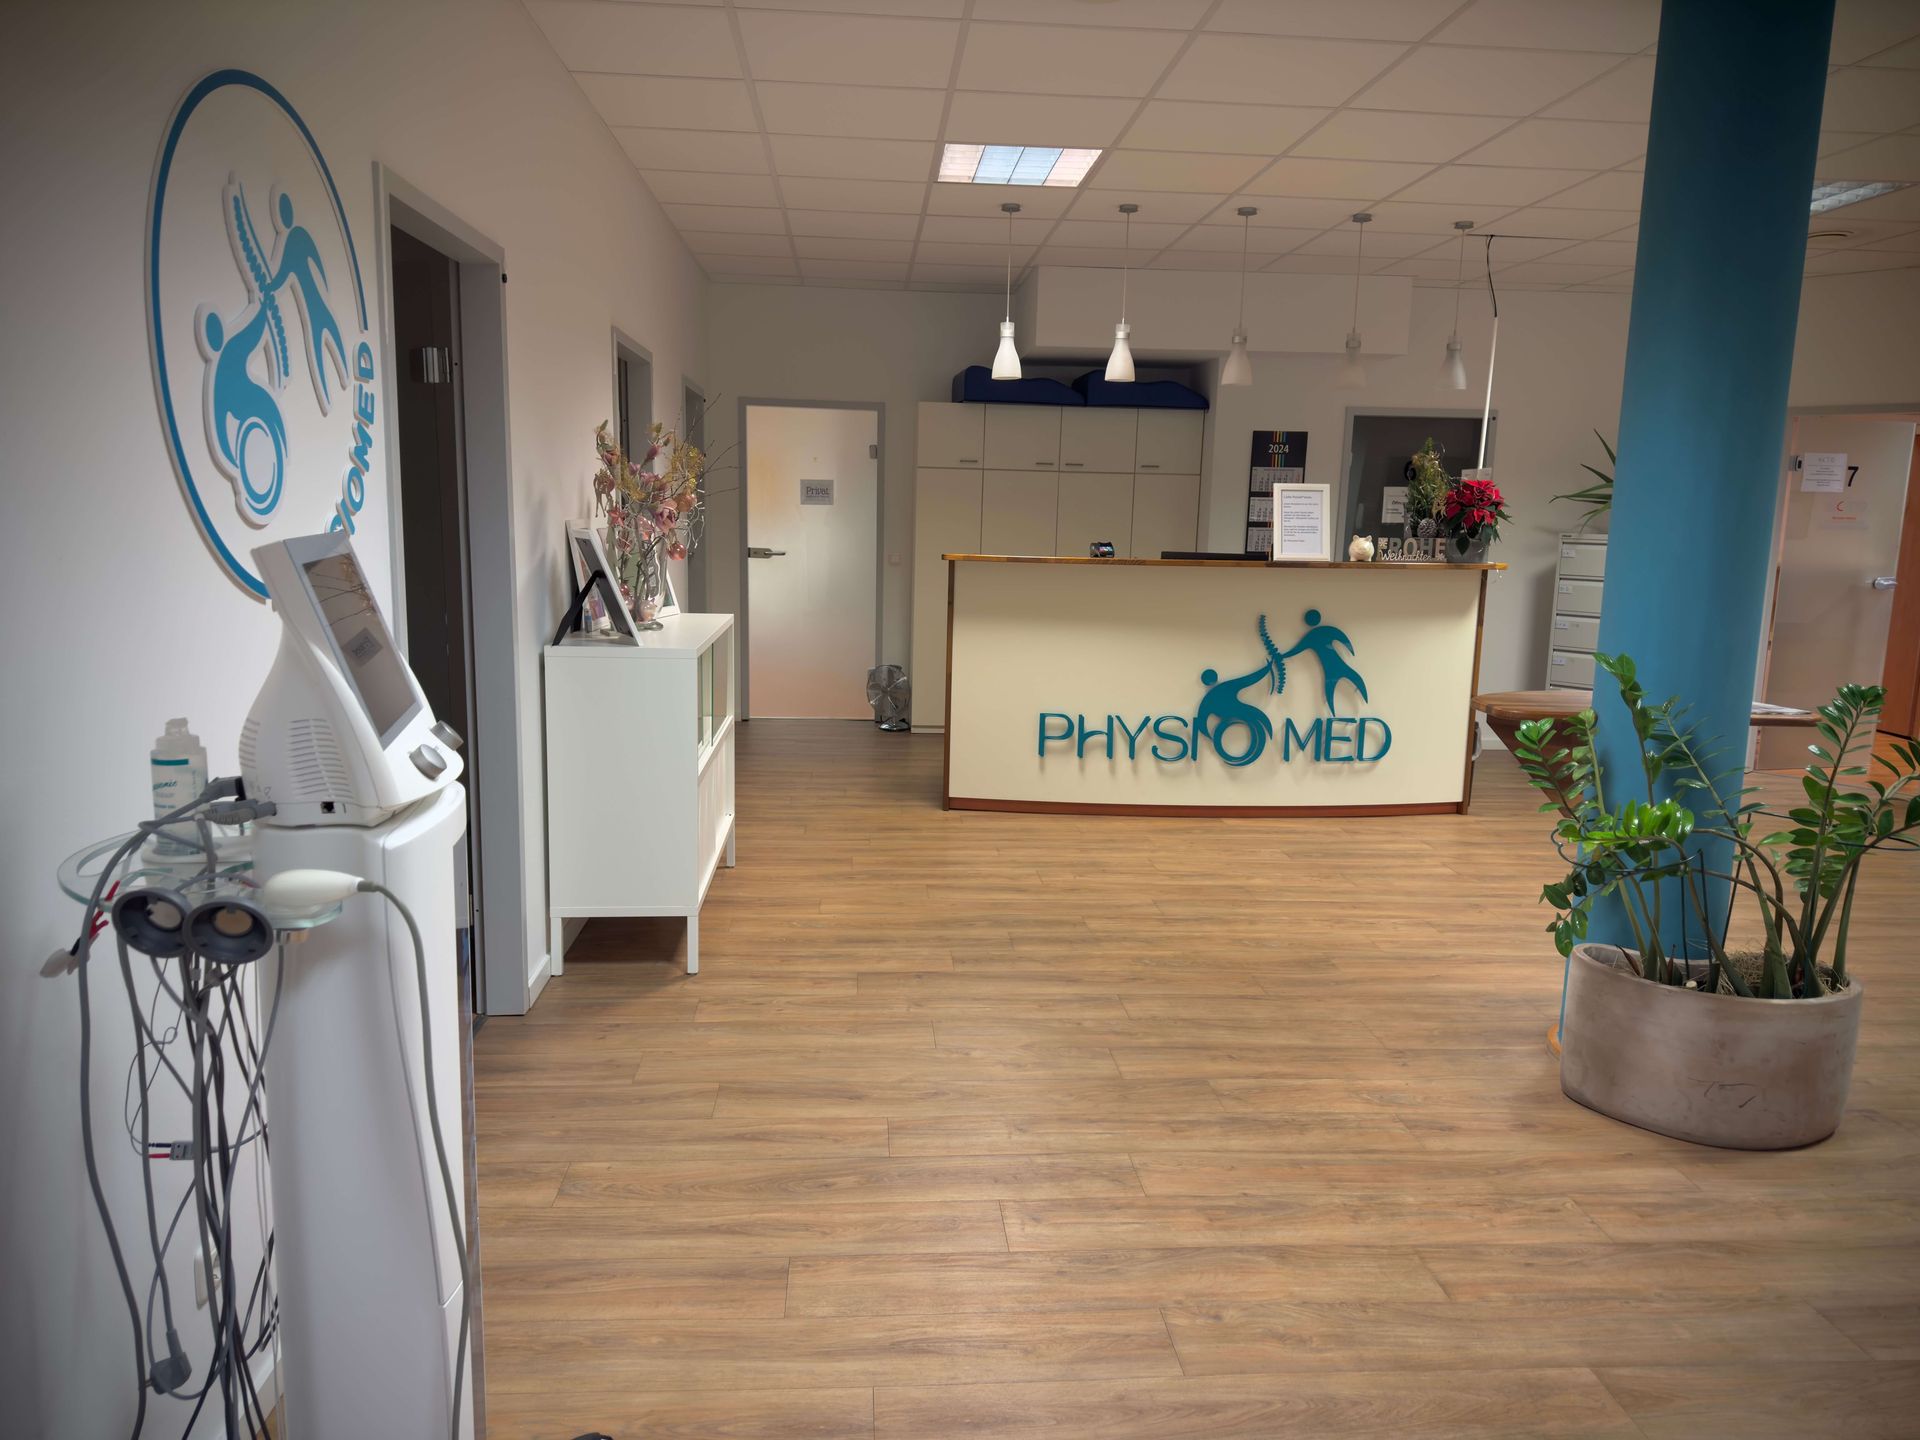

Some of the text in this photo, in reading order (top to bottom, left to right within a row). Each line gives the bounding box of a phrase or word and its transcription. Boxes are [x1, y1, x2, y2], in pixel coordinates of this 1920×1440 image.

[1268, 444, 1289, 454] 2024
[1404, 460, 1416, 481] 6
[1847, 466, 1859, 487] 7
[1376, 537, 1447, 562] FROHE
